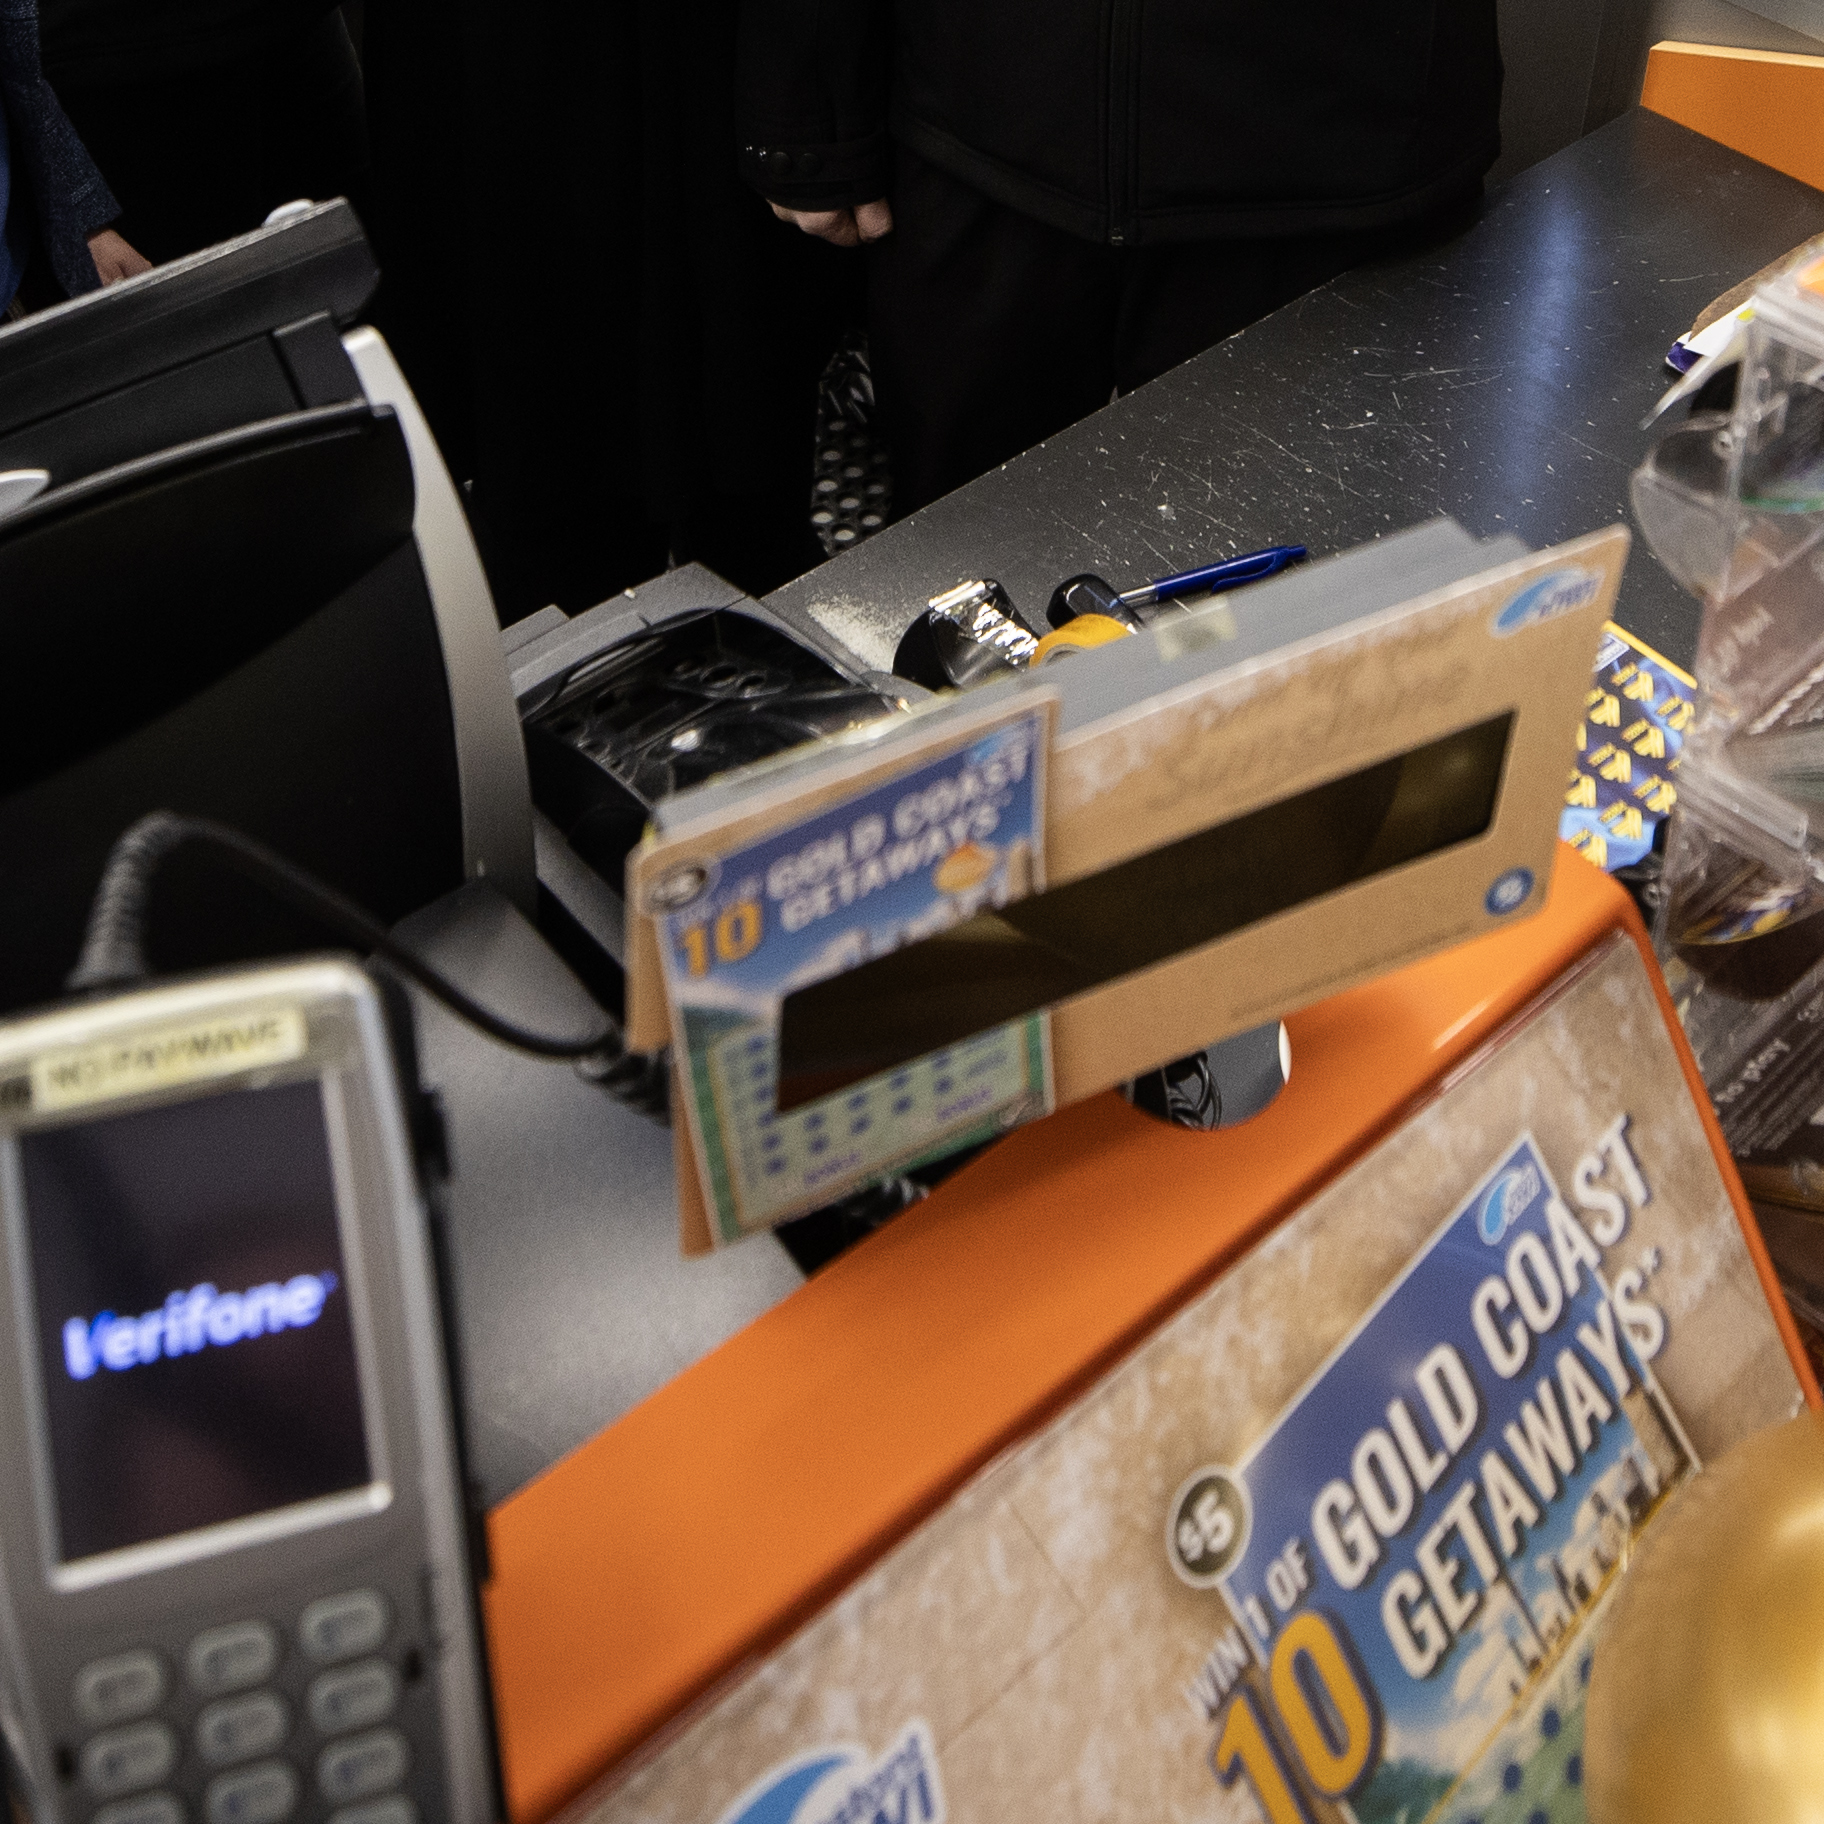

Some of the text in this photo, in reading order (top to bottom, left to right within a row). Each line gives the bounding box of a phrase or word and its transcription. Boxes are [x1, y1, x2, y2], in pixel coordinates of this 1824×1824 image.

[766, 812, 887, 900] GOLD
[681, 896, 764, 977] 10
[62, 1273, 326, 1381] Verifone
[1310, 1113, 1651, 1591] GOLD COAST
[1177, 1490, 1236, 1565] $5
[1182, 1624, 1250, 1720] WIN
[1265, 1536, 1313, 1610] OF
[1212, 1609, 1381, 1824] 10
